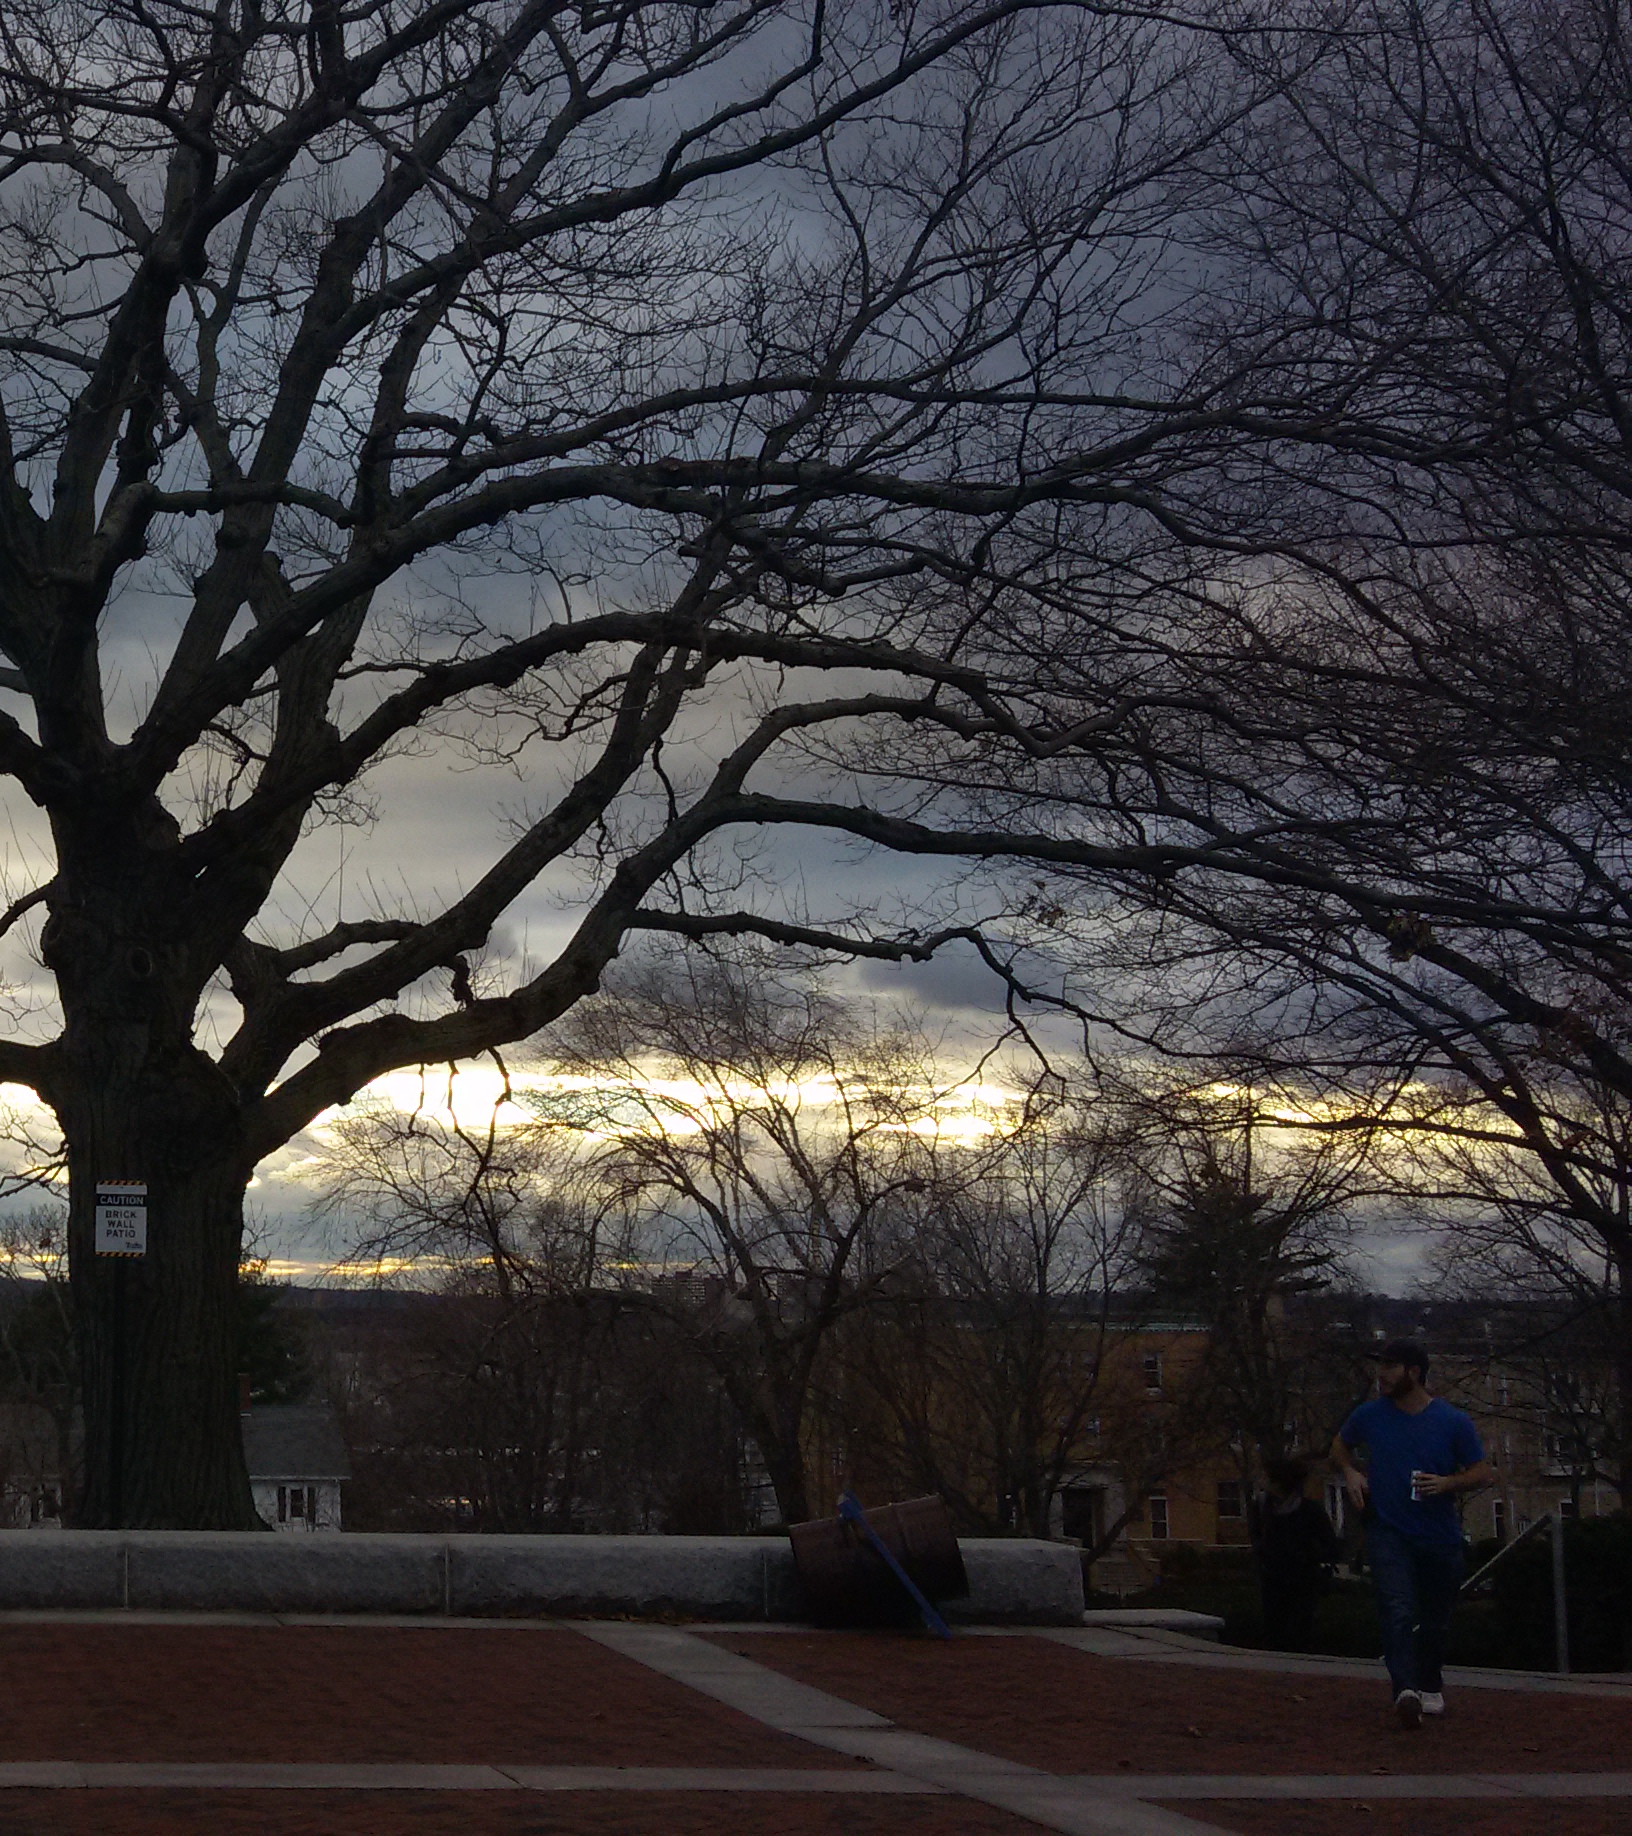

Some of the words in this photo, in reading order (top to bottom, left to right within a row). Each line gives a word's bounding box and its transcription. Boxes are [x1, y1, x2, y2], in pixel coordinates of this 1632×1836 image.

[100, 1196, 144, 1205] CAUTION
[105, 1210, 137, 1218] BRICK
[107, 1220, 134, 1228] WALL
[106, 1230, 136, 1238] PATIO
